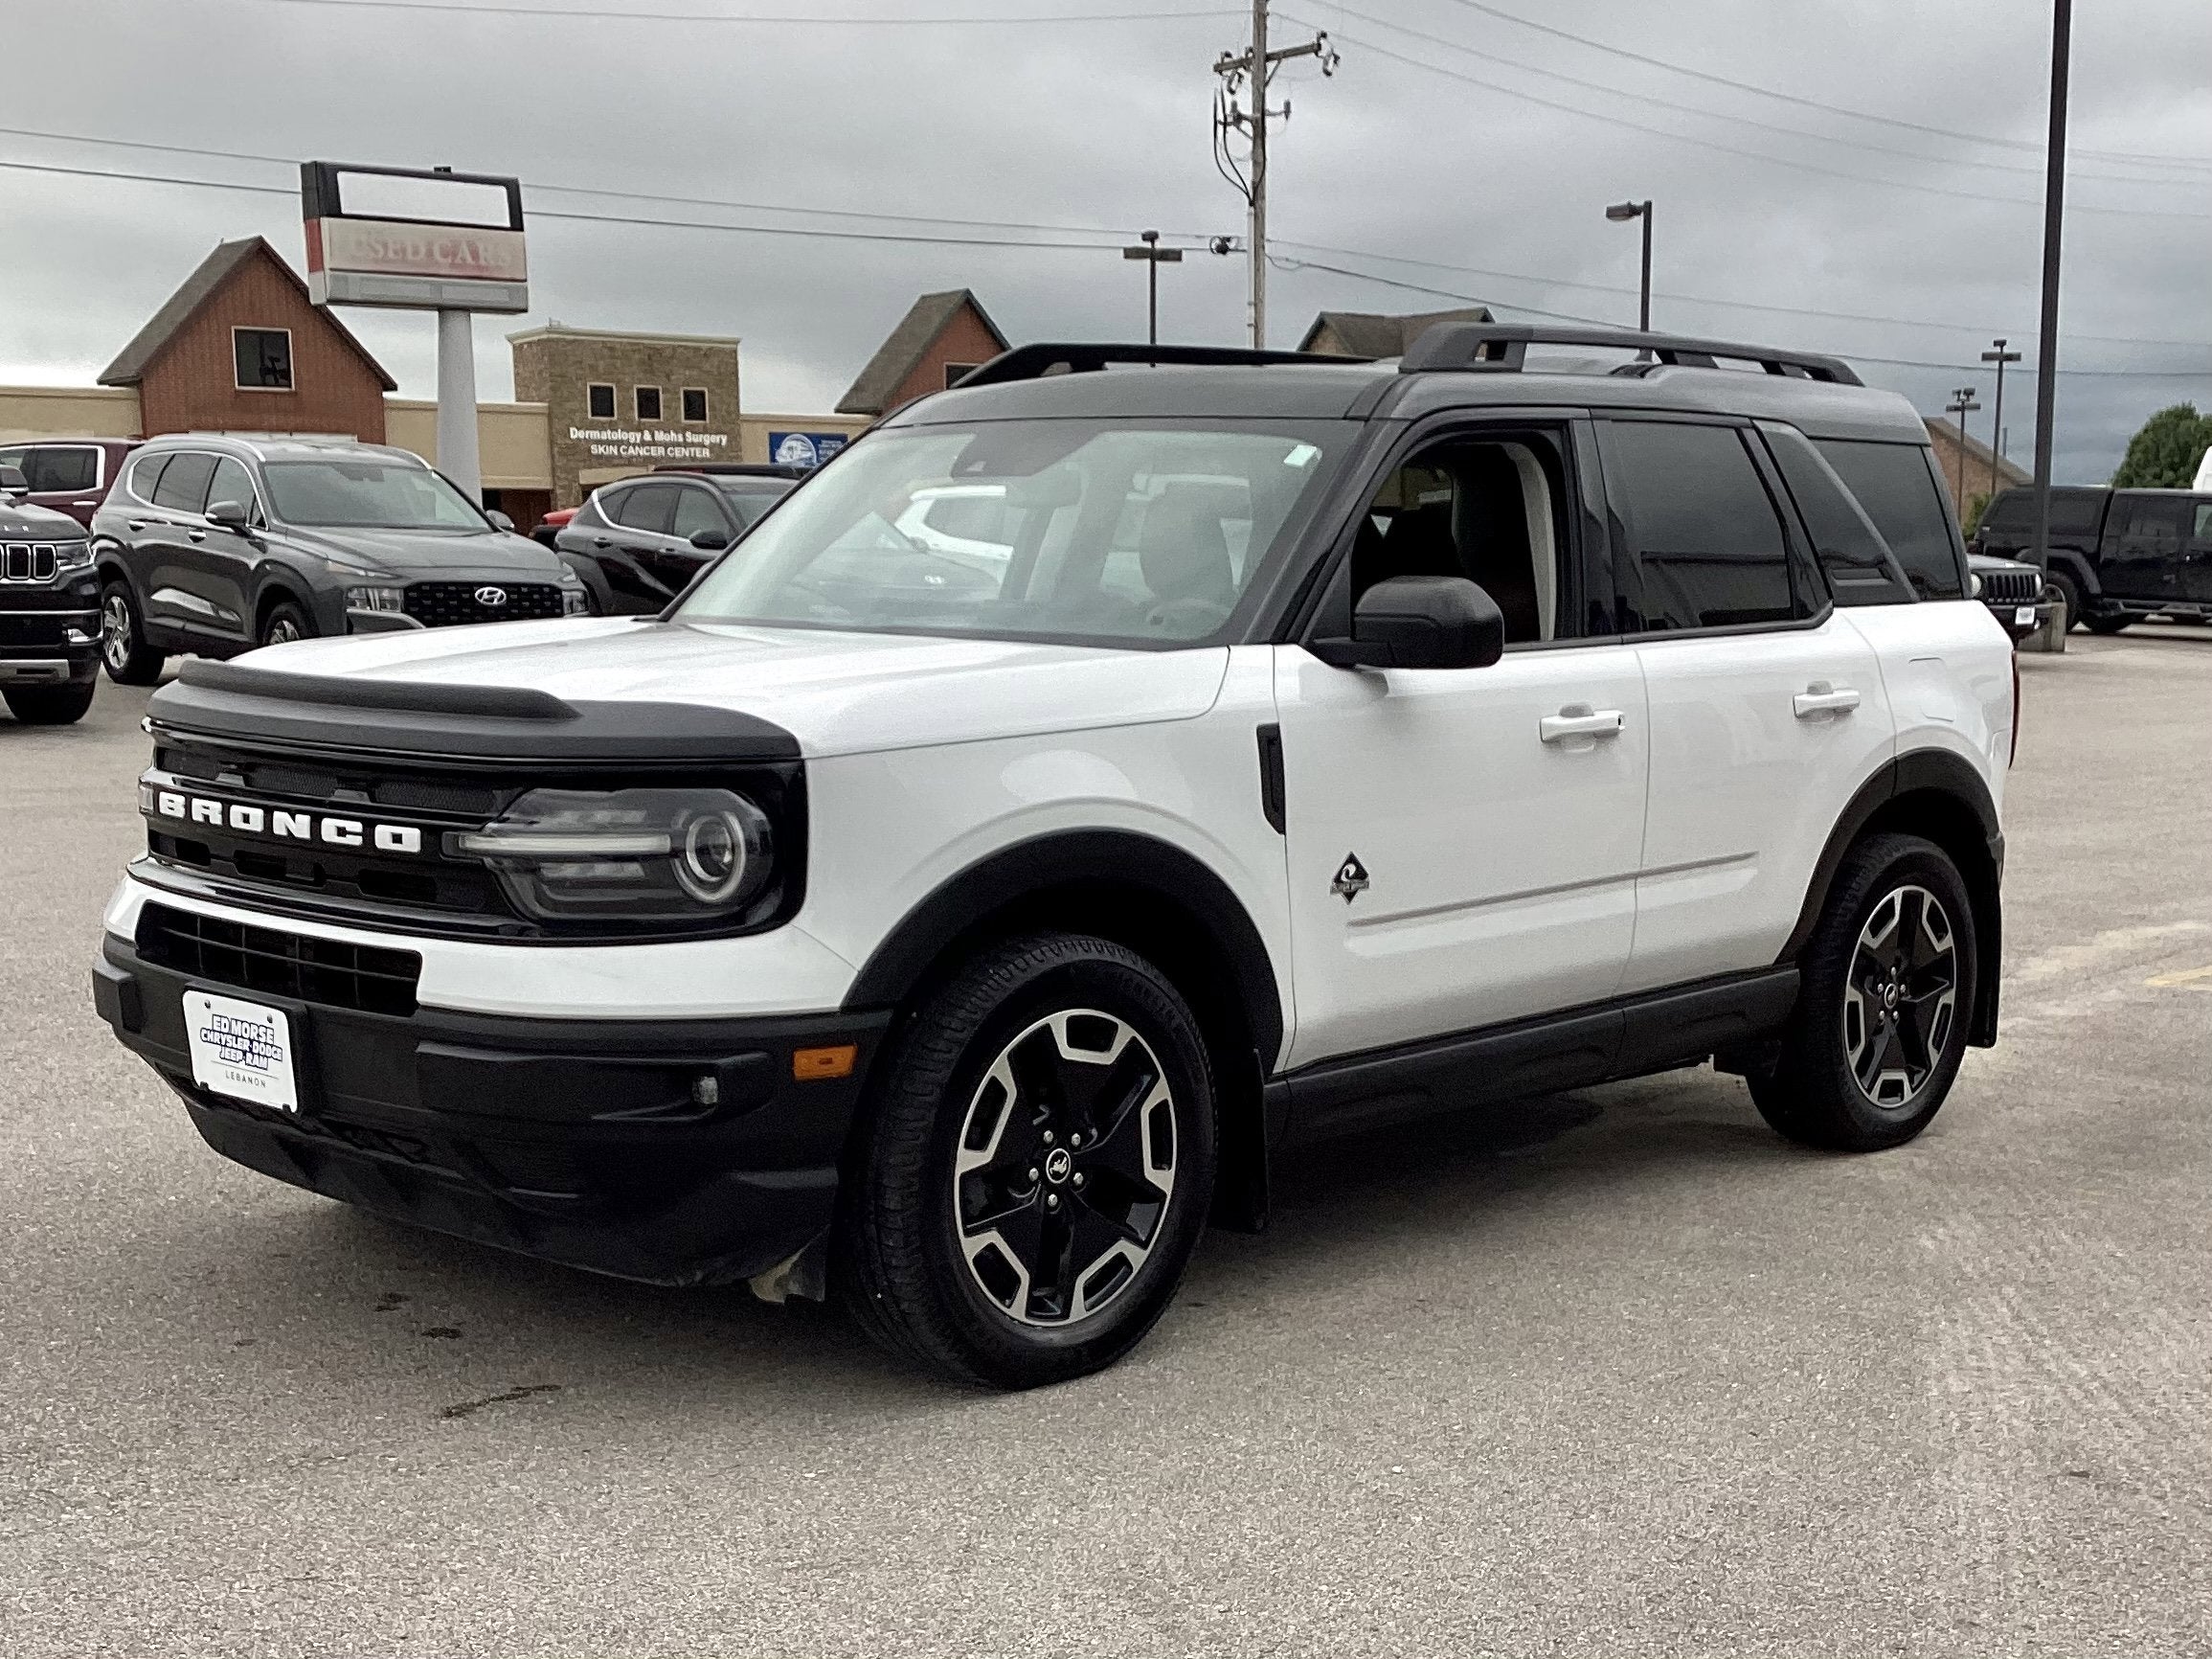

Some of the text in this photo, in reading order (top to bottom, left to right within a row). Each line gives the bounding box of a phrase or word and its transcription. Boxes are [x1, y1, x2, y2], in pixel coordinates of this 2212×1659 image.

[569, 426, 728, 447] Dermatology & Mohs Surgery
[590, 443, 711, 458] SKIN CANCER CENTER
[158, 791, 421, 852] BRONCO
[213, 1014, 275, 1045] ED MORSE
[225, 1070, 266, 1088] LEBANON
